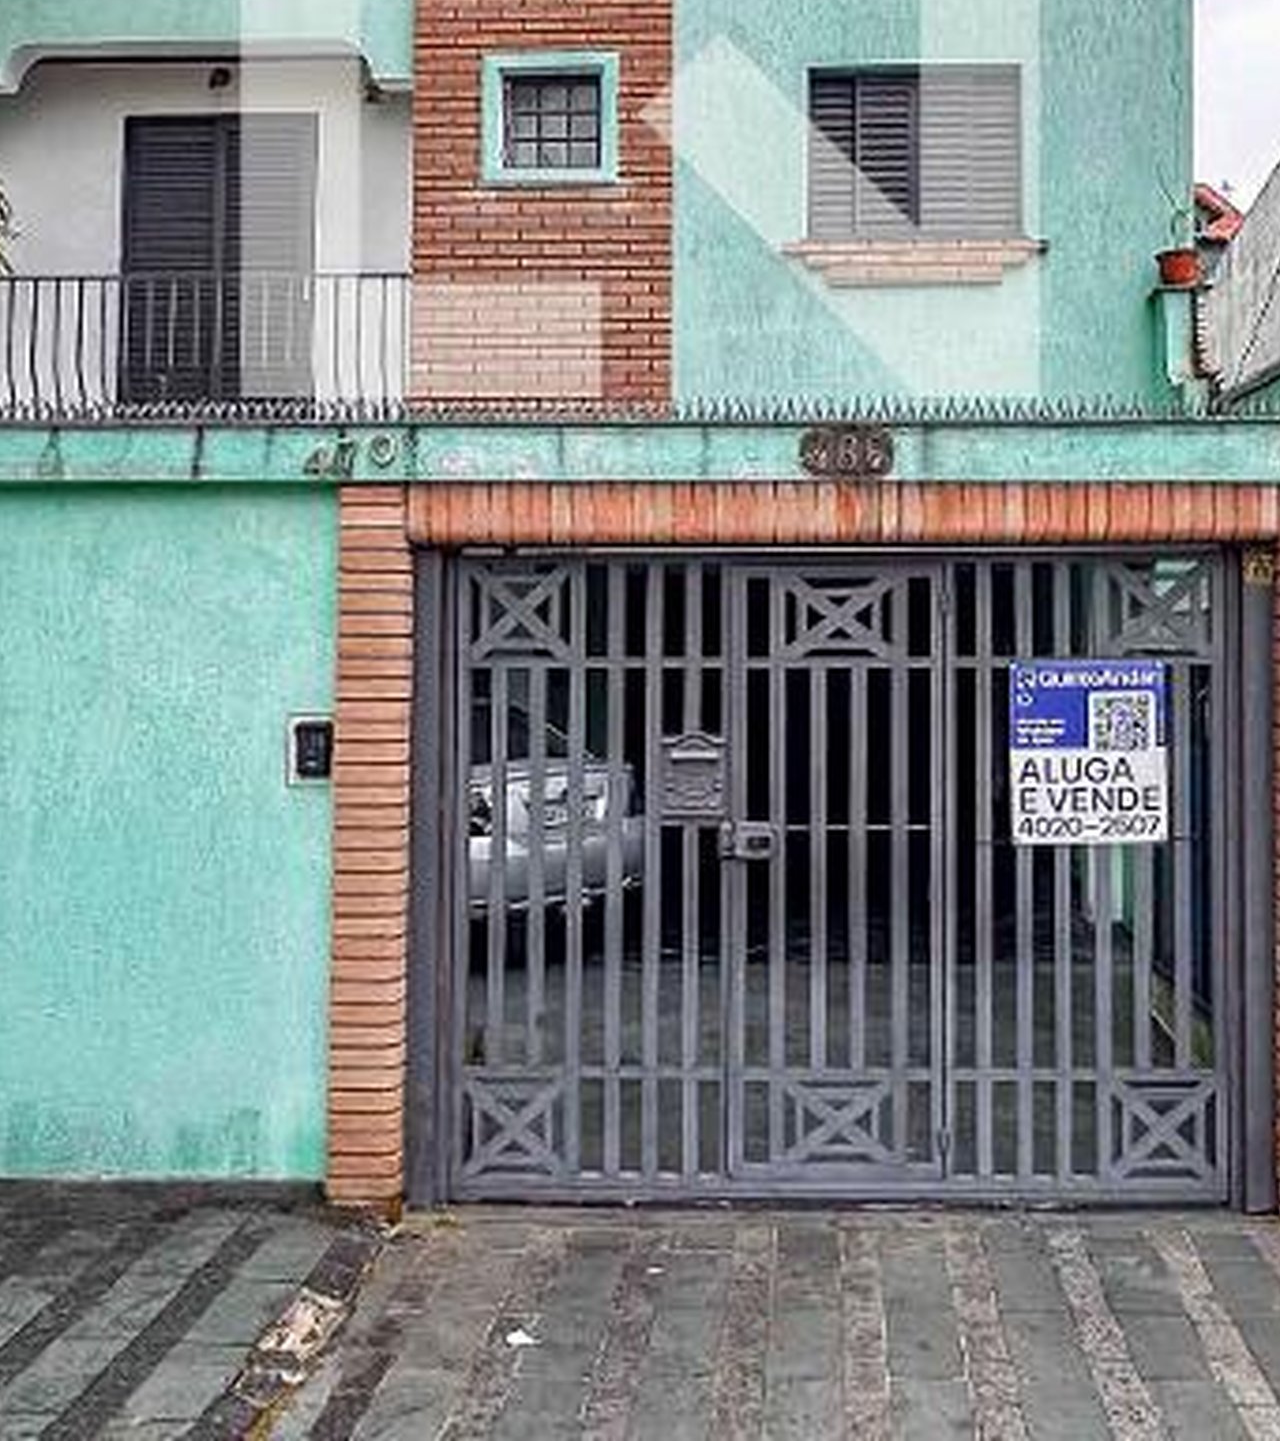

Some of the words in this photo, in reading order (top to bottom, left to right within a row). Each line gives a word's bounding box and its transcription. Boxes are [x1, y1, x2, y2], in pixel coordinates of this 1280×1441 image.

[1019, 757, 1135, 784] ALUGA
[1020, 787, 1037, 814] E
[1046, 787, 1161, 812] VENDE
